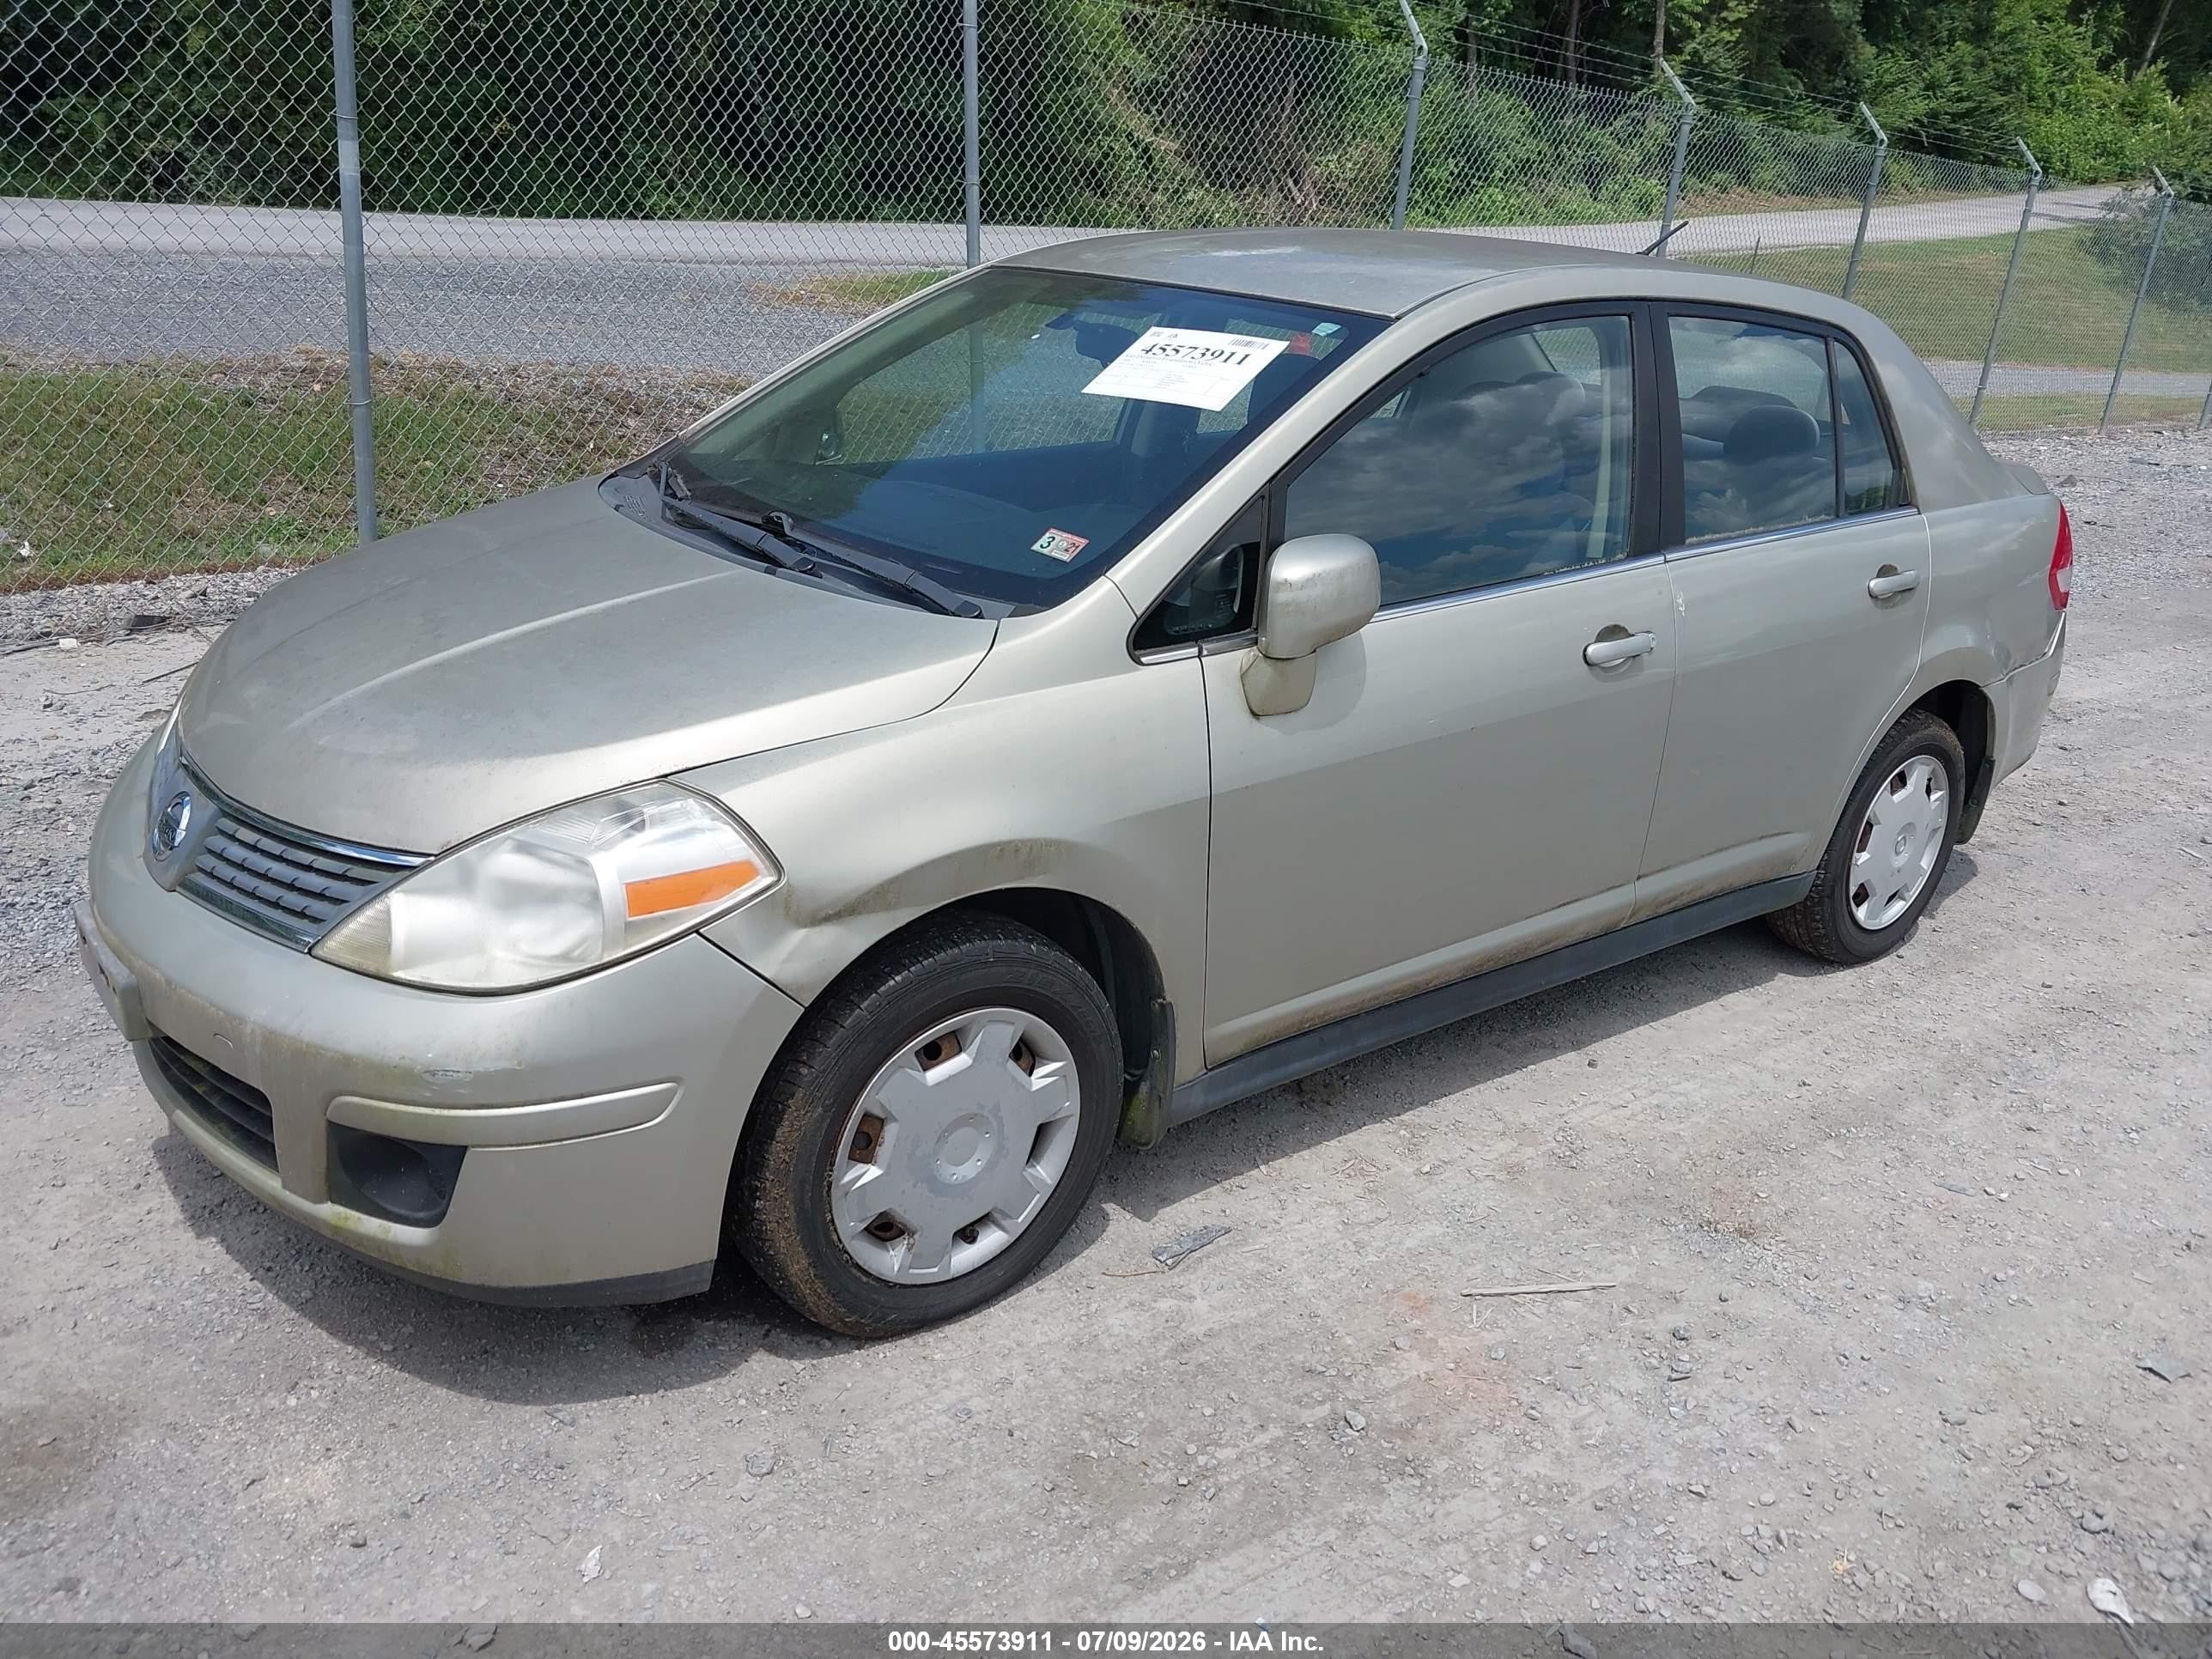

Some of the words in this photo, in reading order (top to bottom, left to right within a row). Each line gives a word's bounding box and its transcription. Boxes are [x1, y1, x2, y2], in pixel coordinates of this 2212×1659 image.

[1140, 343, 1253, 366] 45573911
[1040, 536, 1056, 550] 3
[1064, 542, 1081, 555] 21
